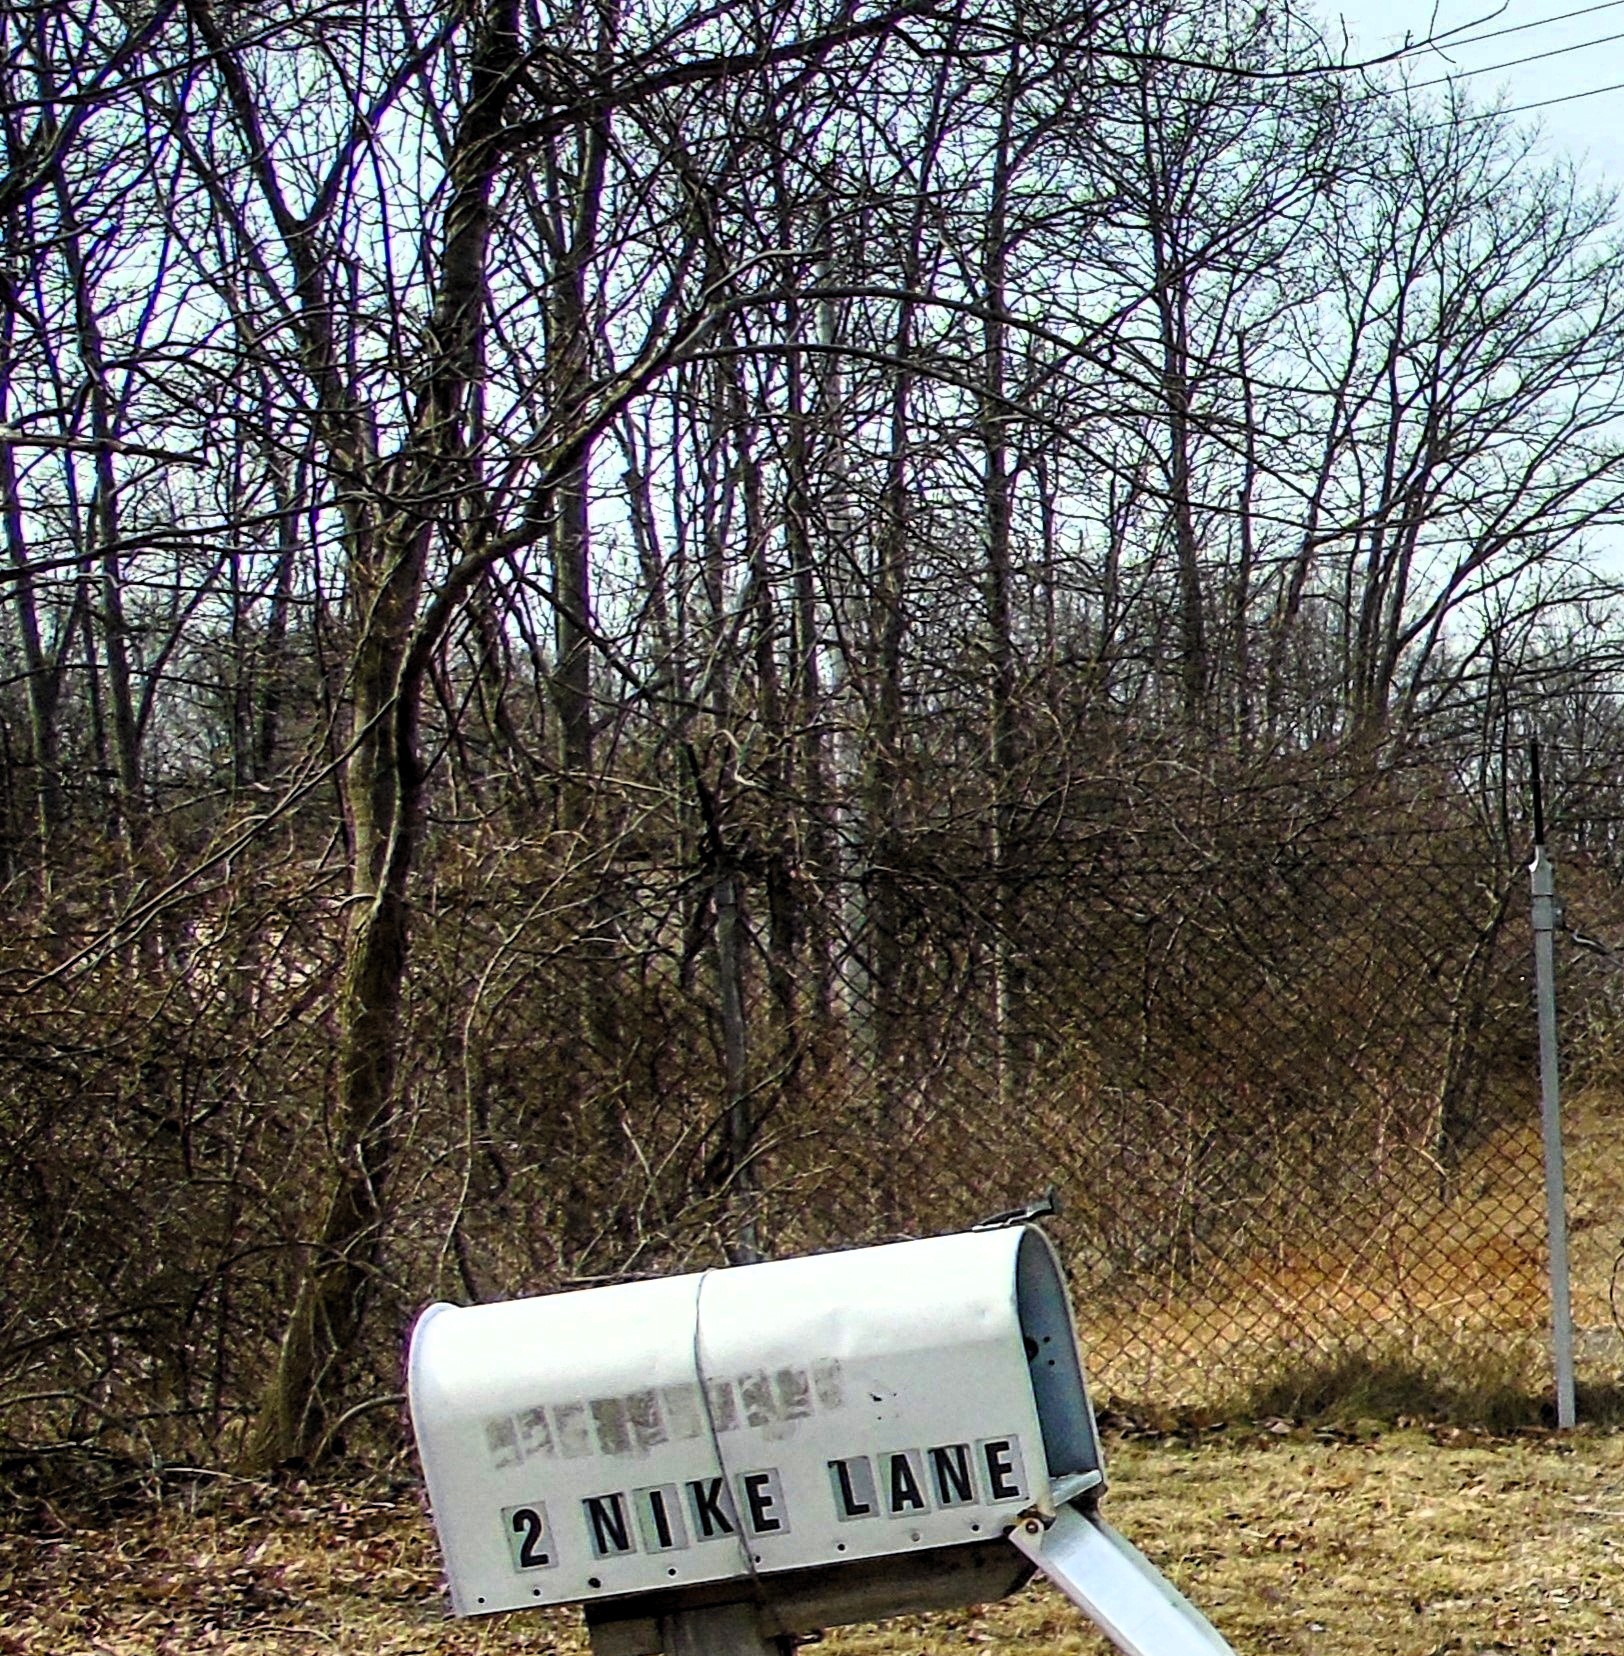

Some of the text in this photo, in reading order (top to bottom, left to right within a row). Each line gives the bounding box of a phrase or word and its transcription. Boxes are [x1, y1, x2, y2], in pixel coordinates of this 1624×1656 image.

[511, 1440, 1022, 1568] 2 NIKE LANE
